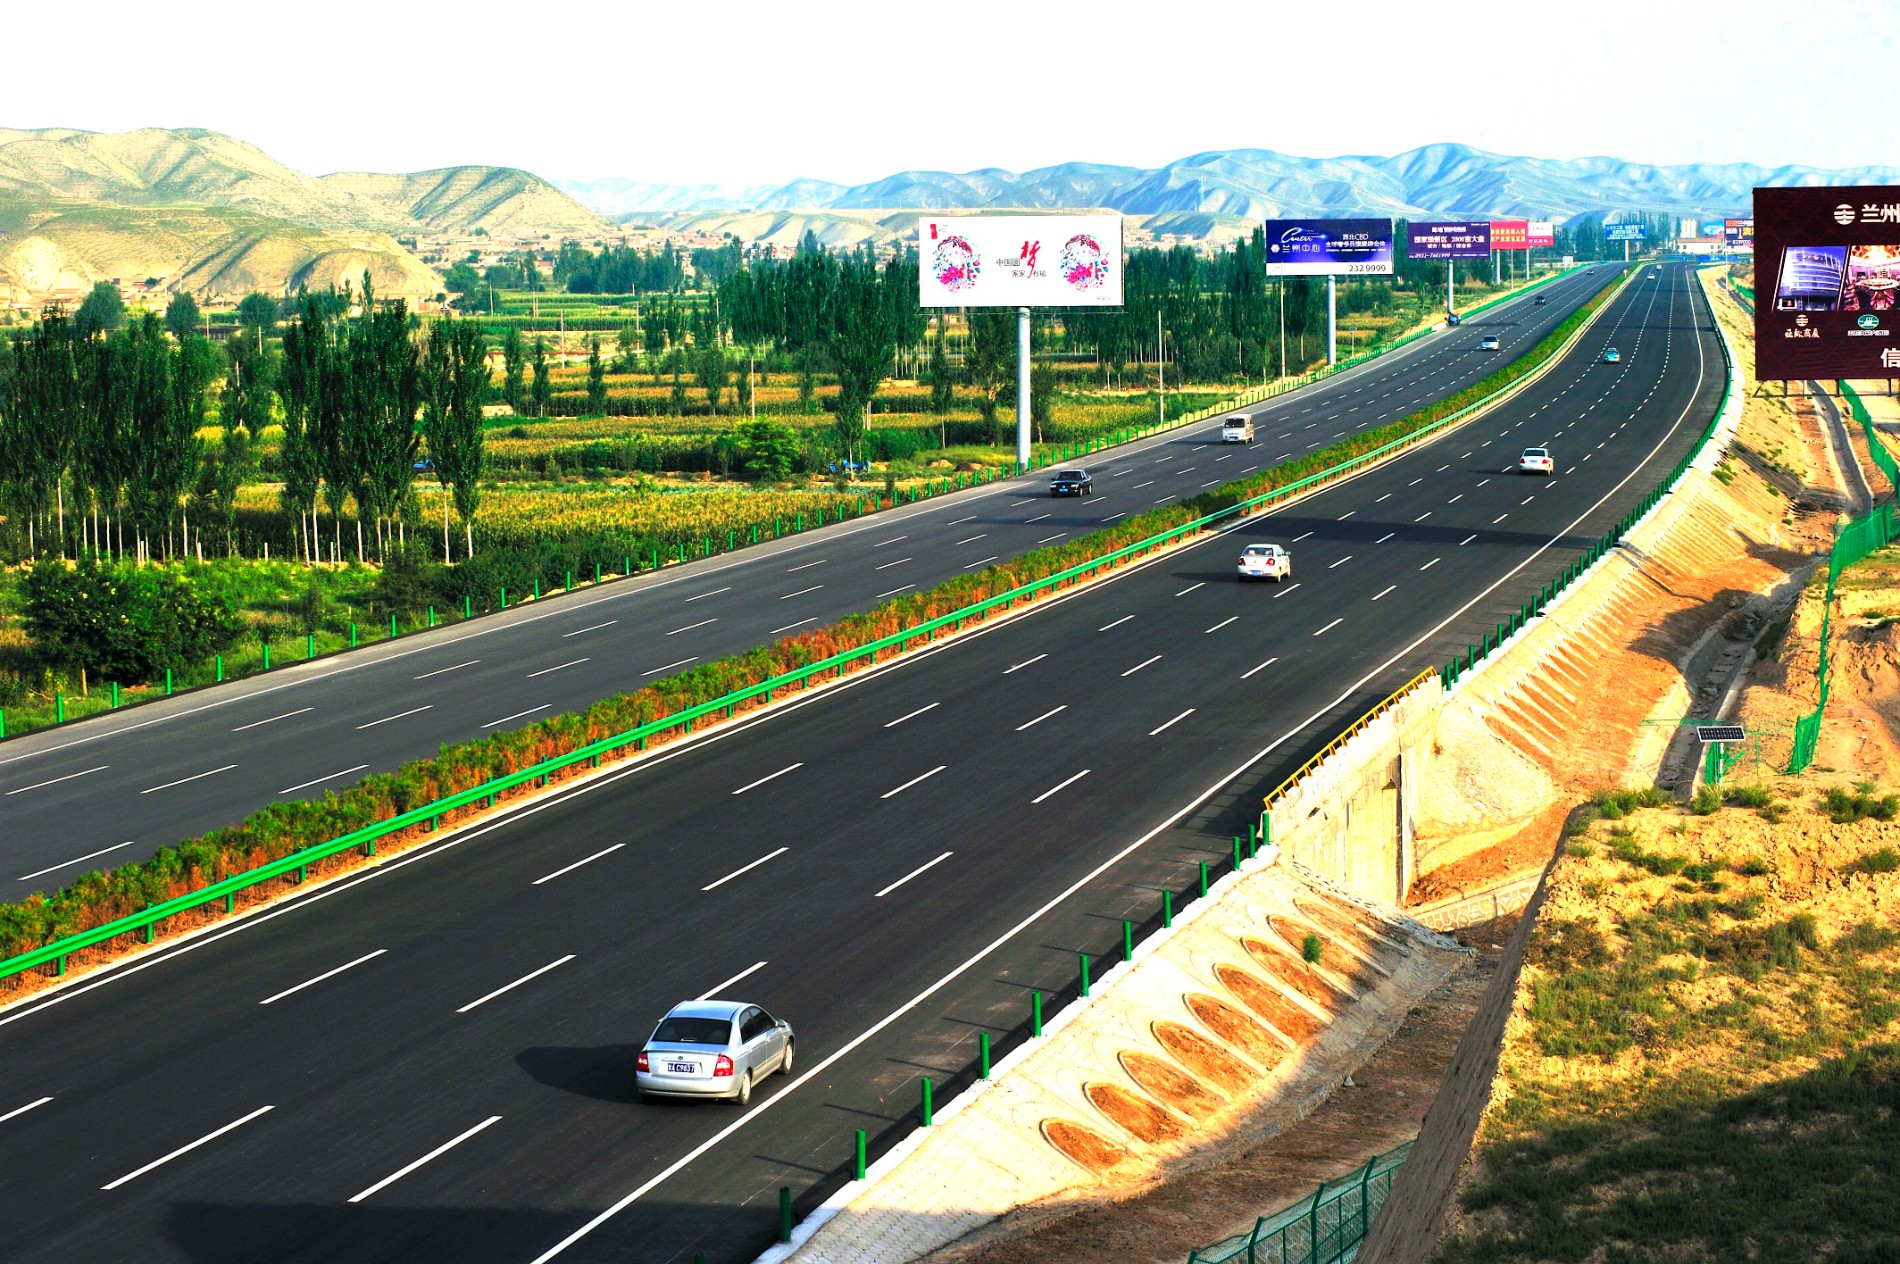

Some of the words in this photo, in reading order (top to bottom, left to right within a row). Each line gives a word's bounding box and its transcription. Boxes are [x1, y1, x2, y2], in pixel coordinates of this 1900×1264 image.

[1860, 203, 1900, 223] 兰州
[1282, 244, 1320, 253] 兰州中心
[1880, 347, 1900, 368] 信
